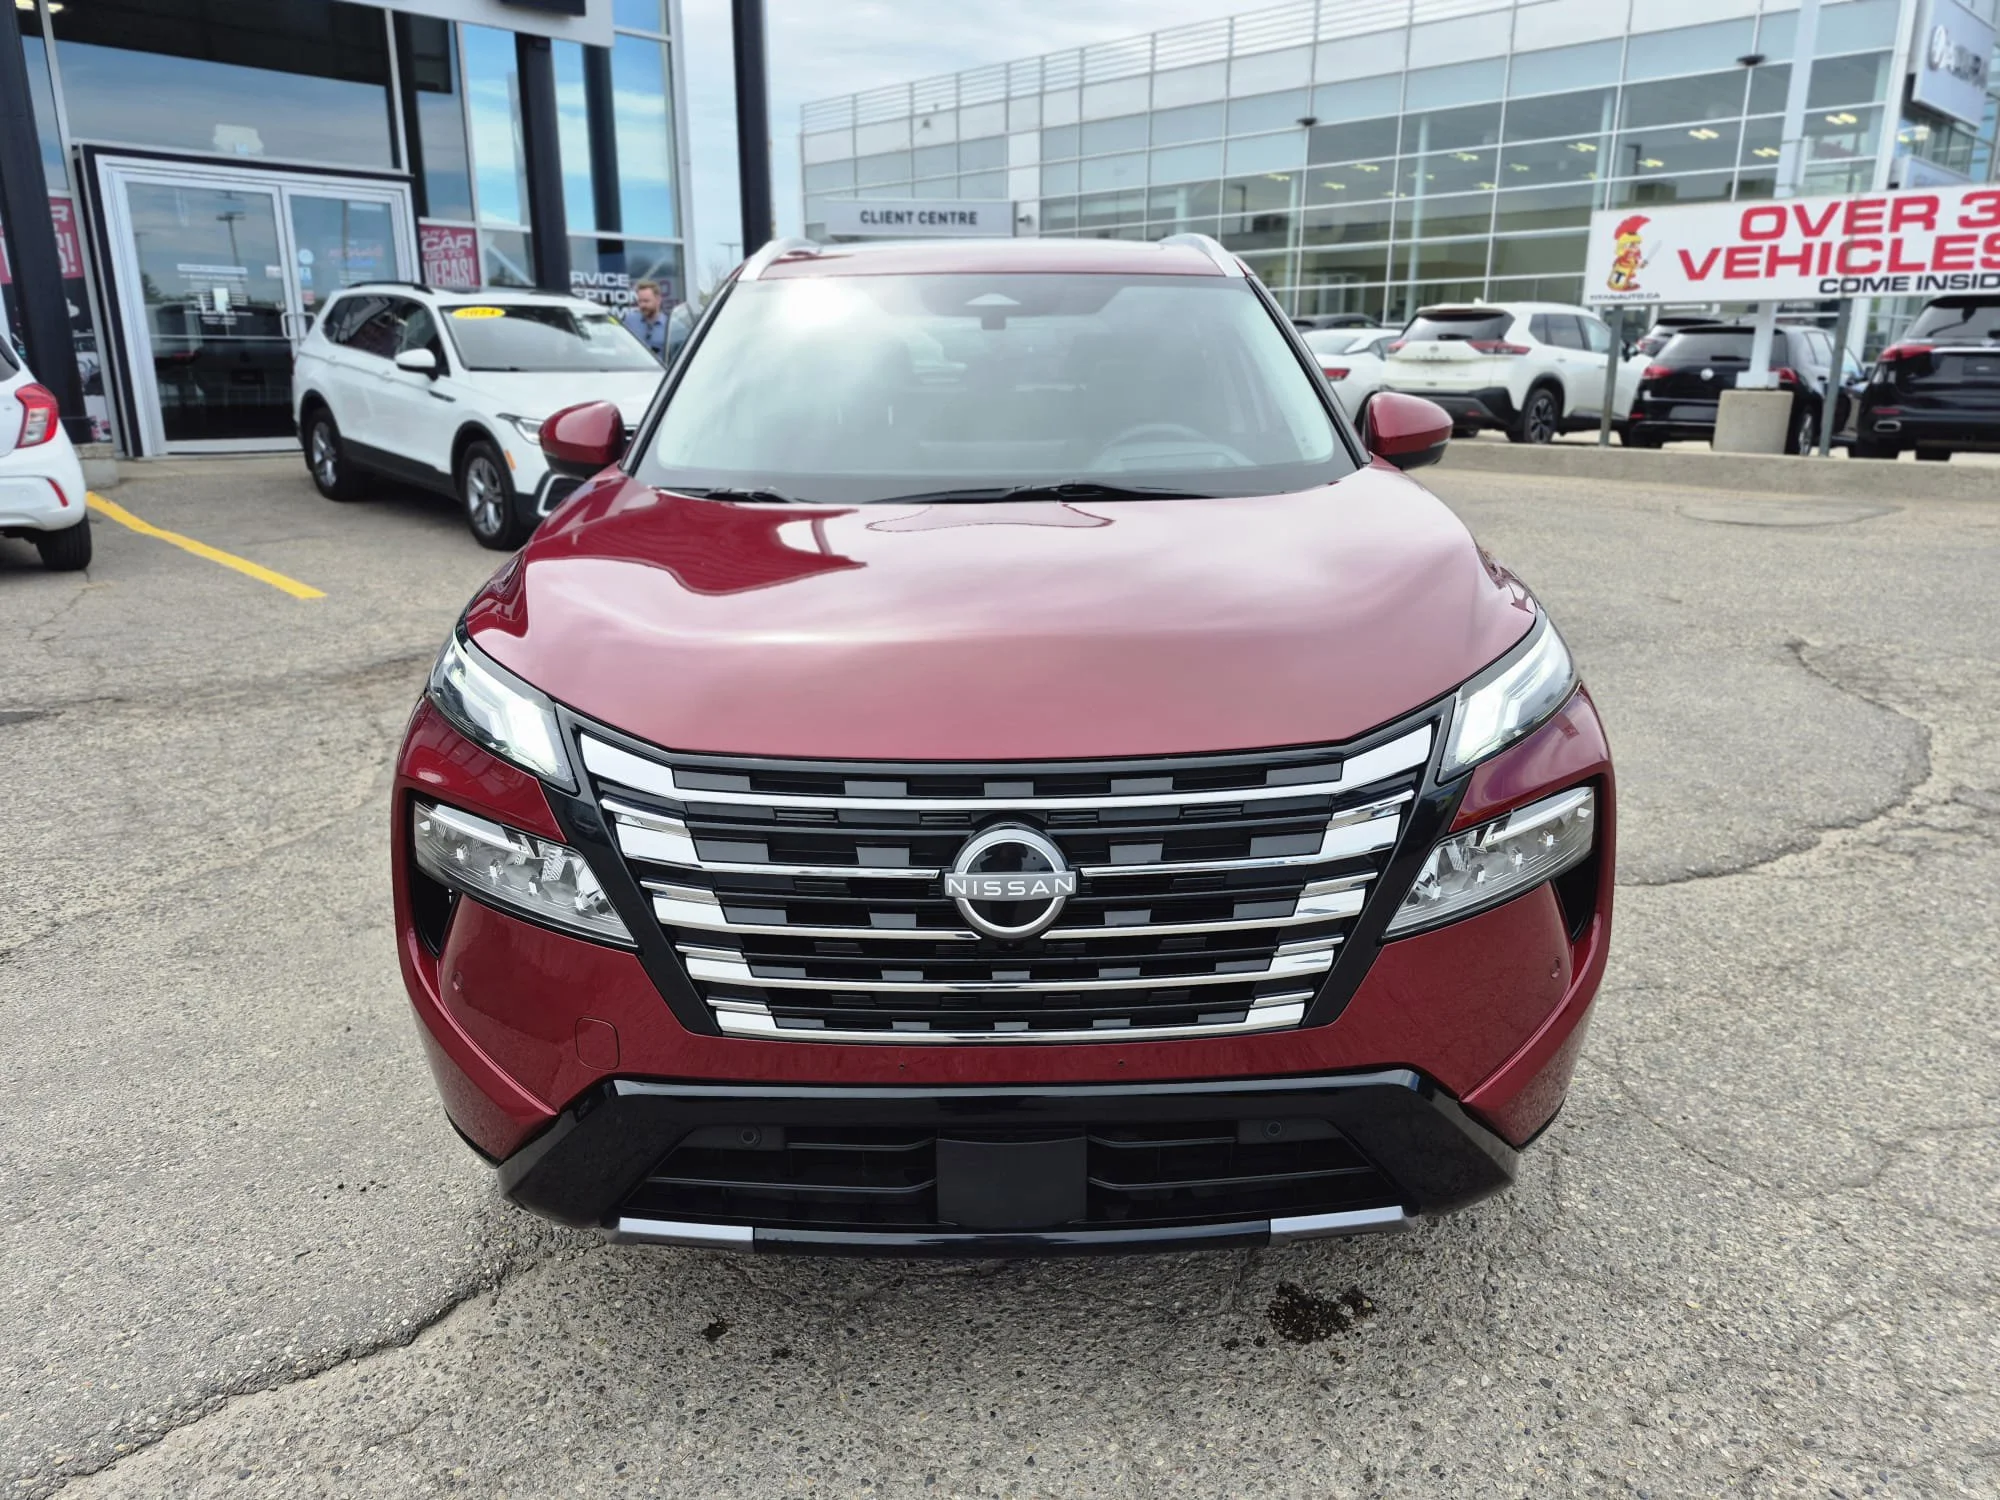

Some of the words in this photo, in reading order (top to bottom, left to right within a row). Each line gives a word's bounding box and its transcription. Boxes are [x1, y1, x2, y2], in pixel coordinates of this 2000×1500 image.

[860, 210, 914, 225] CLIENT
[918, 210, 978, 225] CENTRE
[1739, 195, 1940, 241] OVER
[421, 234, 473, 252] CAR
[423, 257, 476, 287] VEGAS!
[570, 271, 630, 288] RVICE
[1819, 276, 1910, 294] COME
[571, 288, 639, 304] EPTION
[948, 876, 1073, 896] NISSAN
